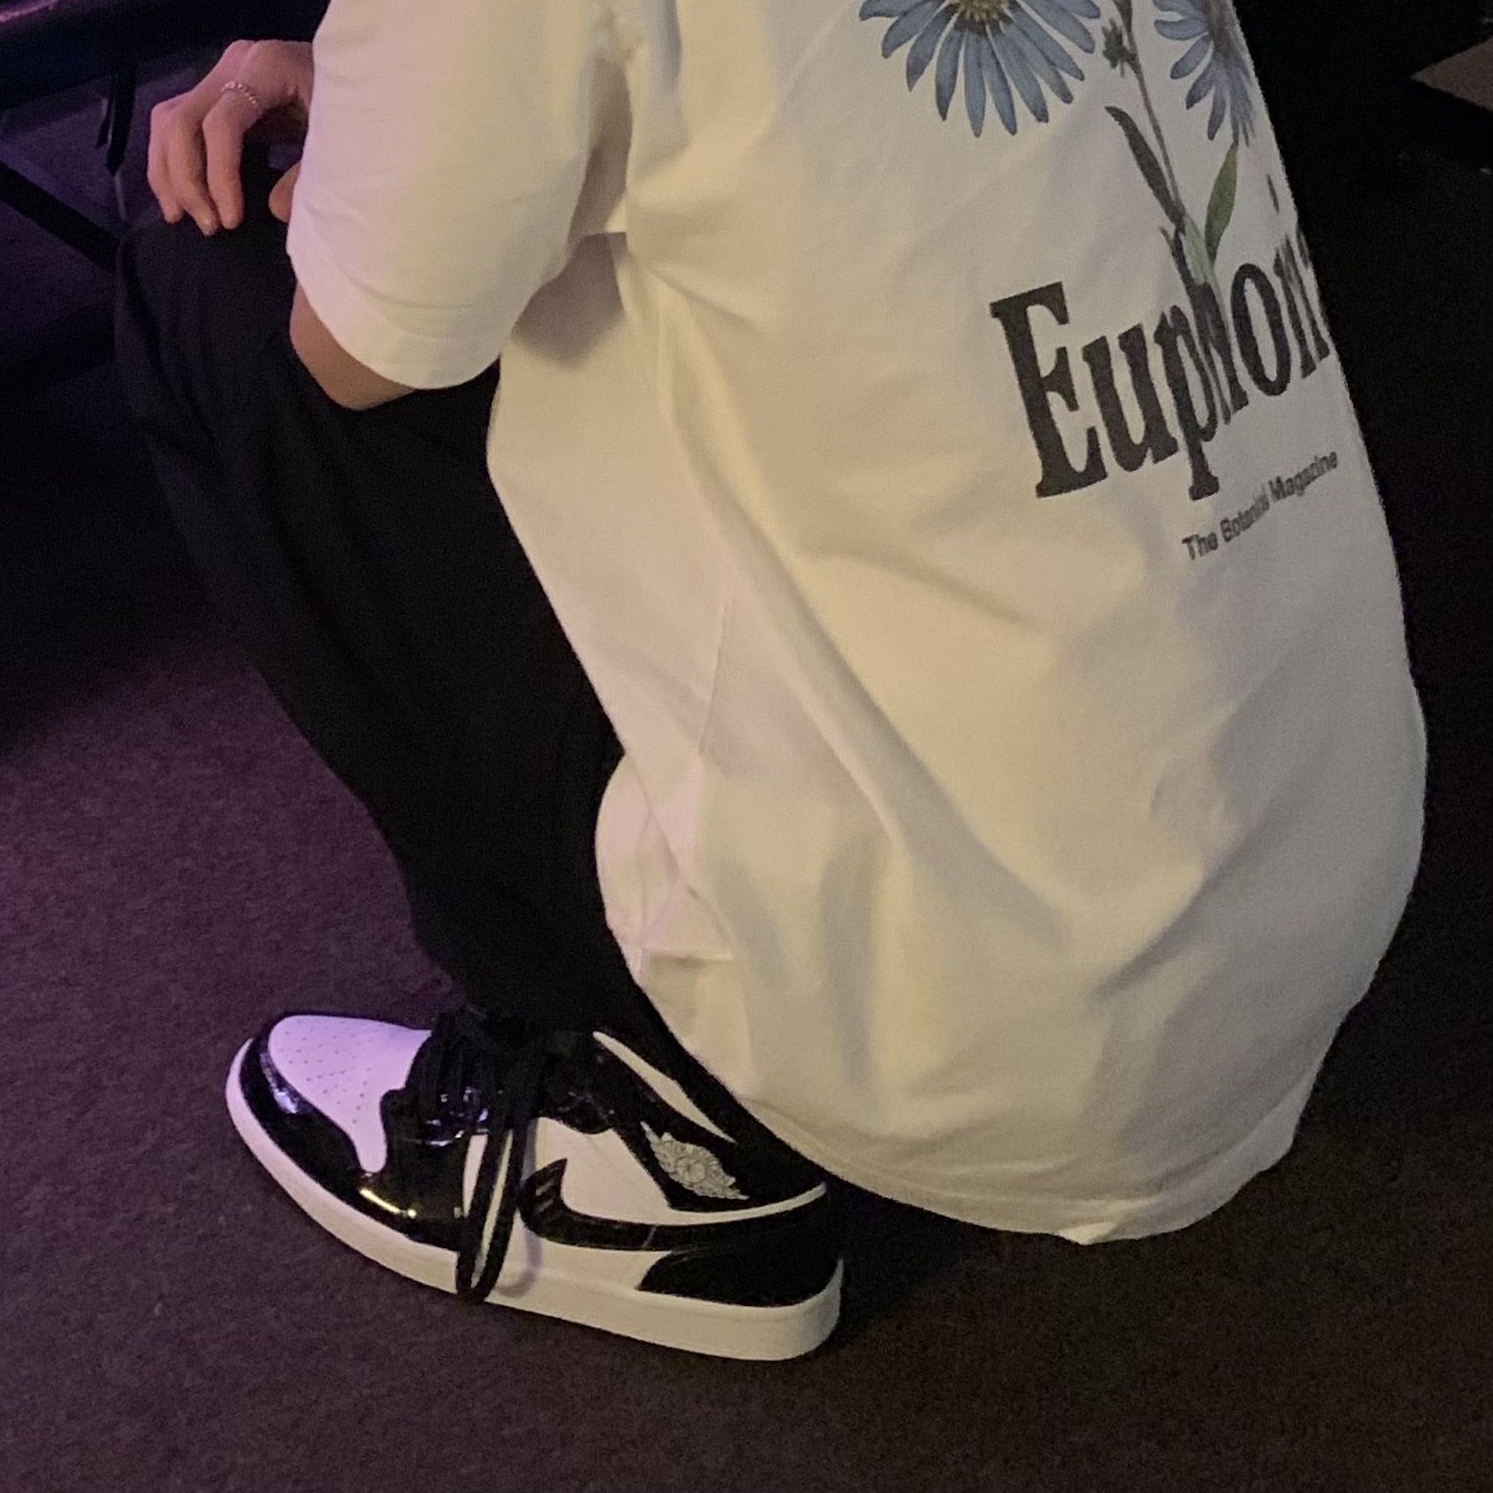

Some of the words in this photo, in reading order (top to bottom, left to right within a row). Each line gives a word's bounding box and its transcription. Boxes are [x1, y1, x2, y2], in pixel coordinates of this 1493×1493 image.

[989, 229, 1331, 501] Euphon
[1181, 533, 1218, 560] The
[1268, 451, 1338, 502] Magazine
